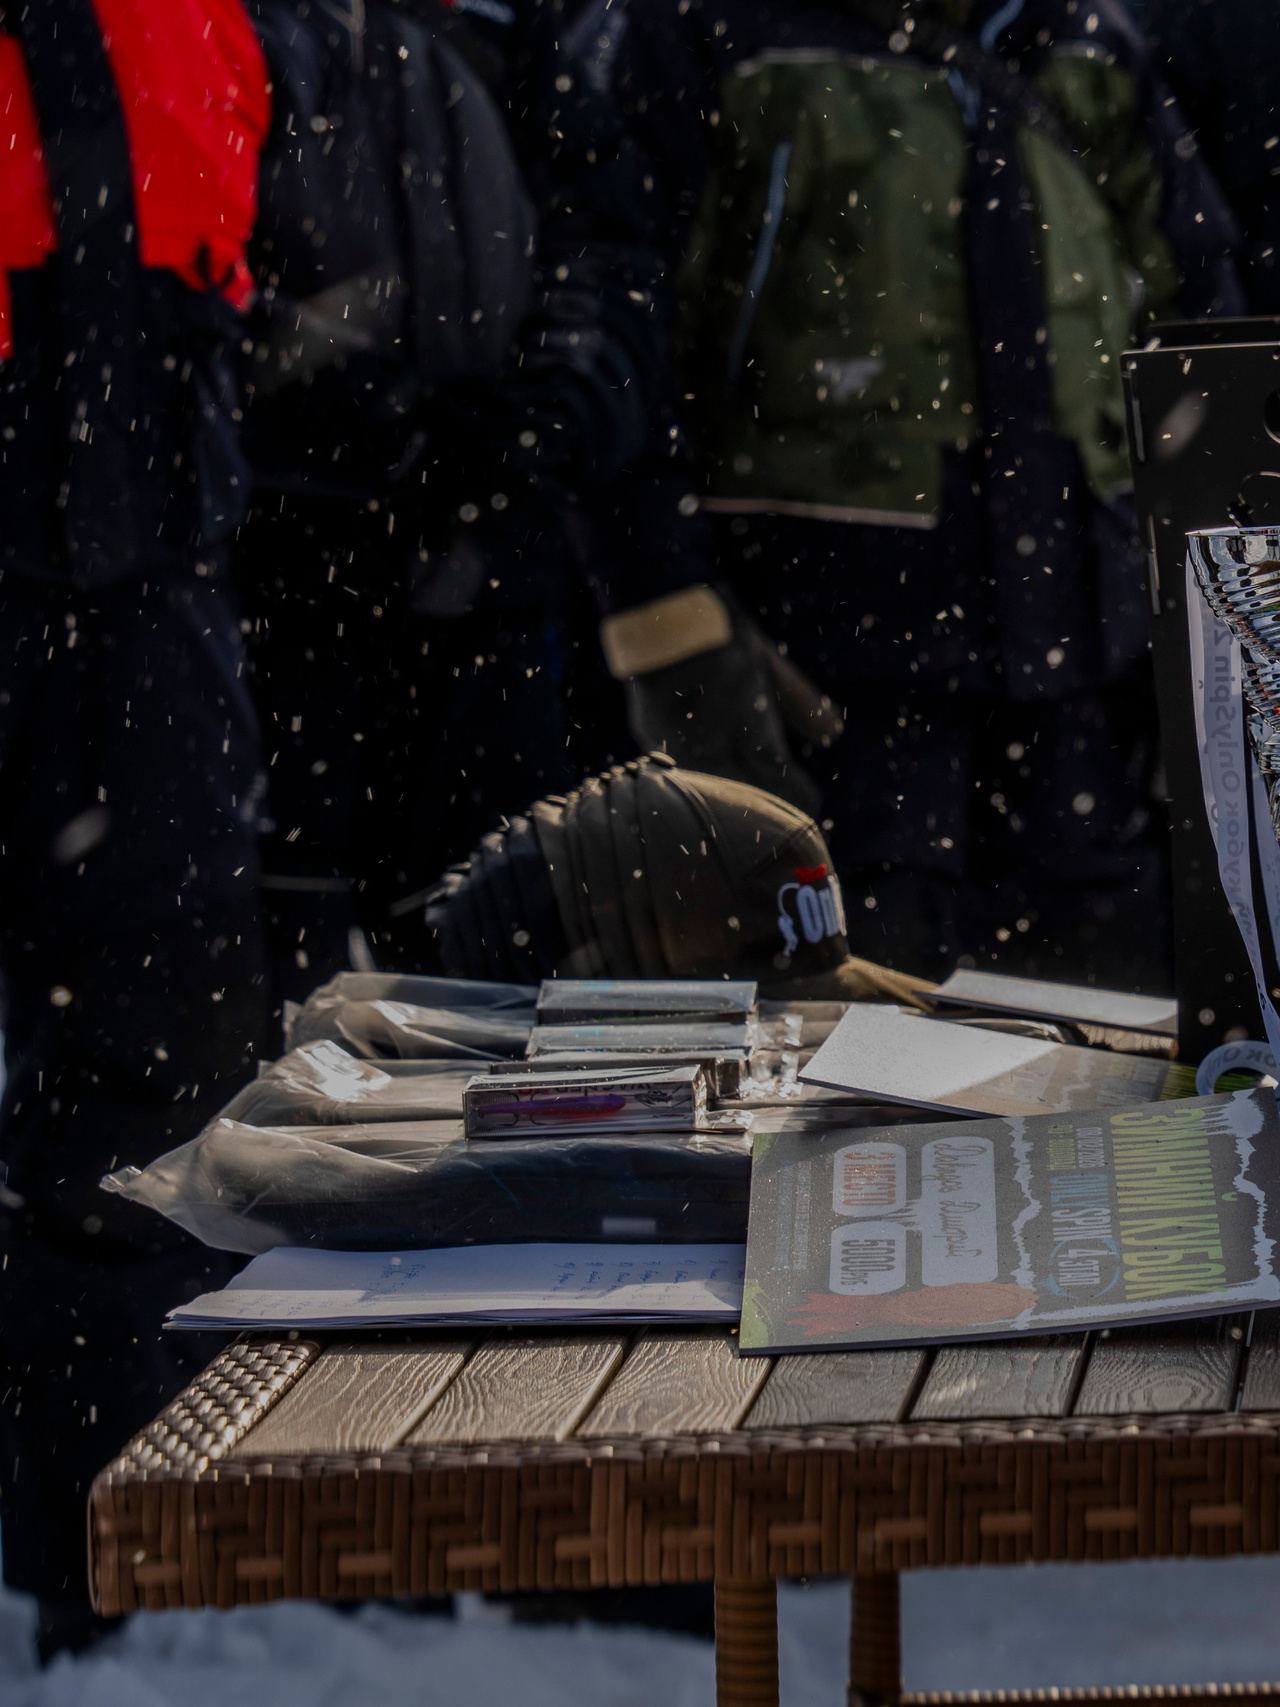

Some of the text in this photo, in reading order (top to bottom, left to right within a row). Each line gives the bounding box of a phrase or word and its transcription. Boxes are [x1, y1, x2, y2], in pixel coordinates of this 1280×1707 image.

[842, 1152, 896, 1206] 3 МЕСТО
[1109, 1108, 1238, 1213] ЗИМНИЙ
[1058, 1259, 1100, 1286] ЭТАП
[1119, 1213, 1228, 1300] КУБОК
